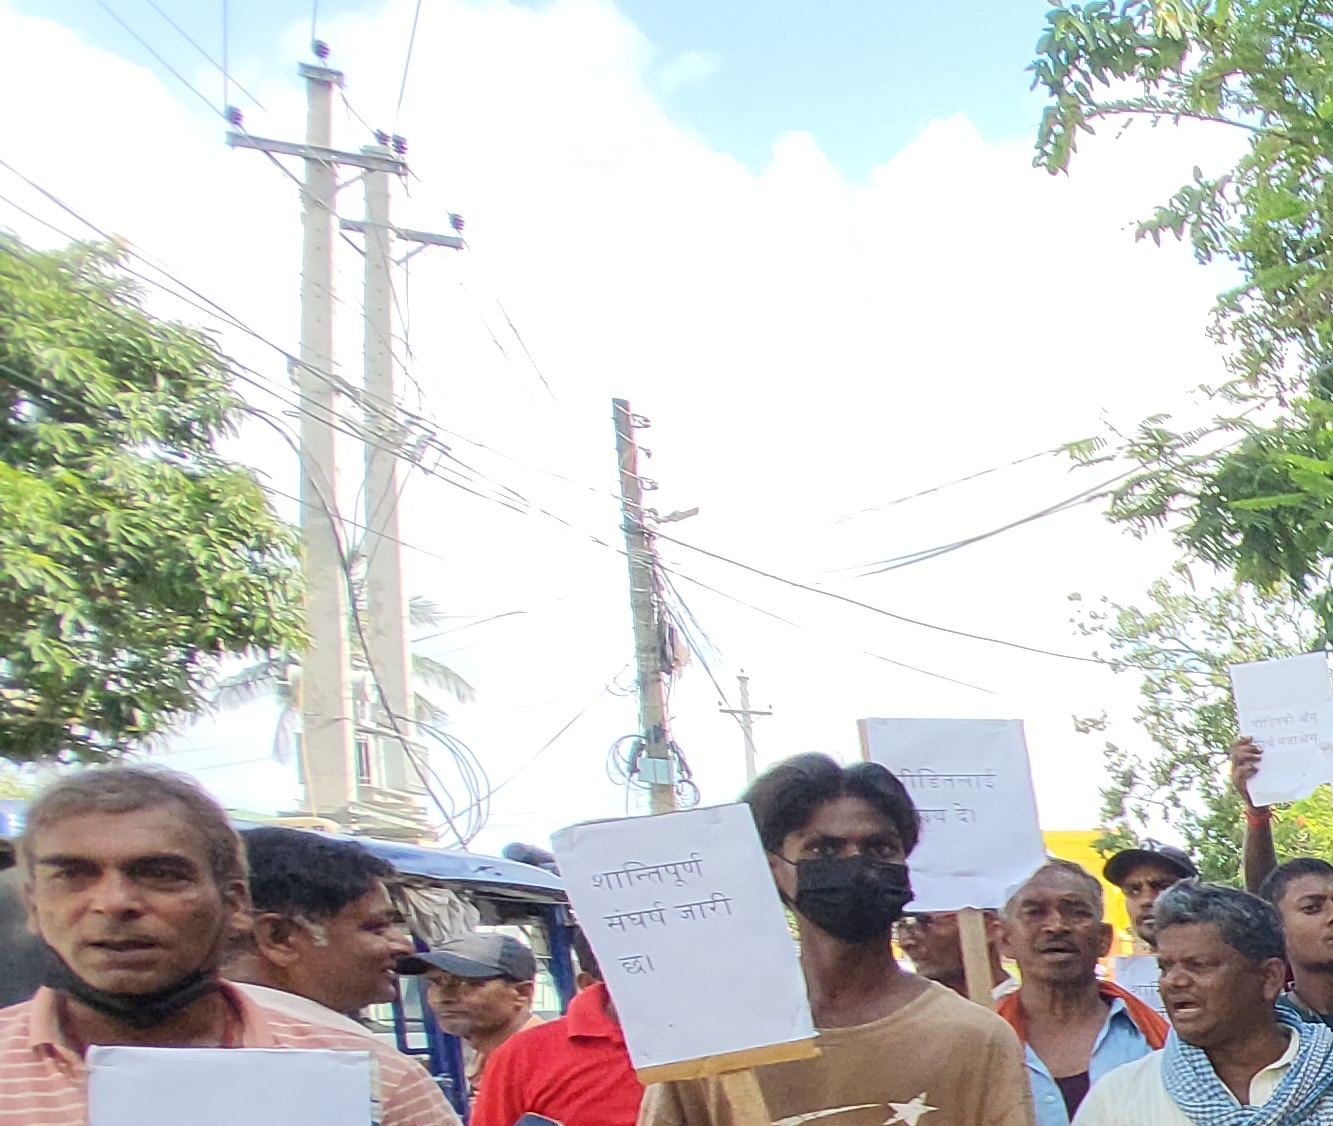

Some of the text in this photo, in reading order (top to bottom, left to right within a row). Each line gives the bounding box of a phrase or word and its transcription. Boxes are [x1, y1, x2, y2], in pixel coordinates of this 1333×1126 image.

[591, 853, 703, 890] शान्तिपूर्ण
[603, 892, 732, 932] संघर्ष जारी
